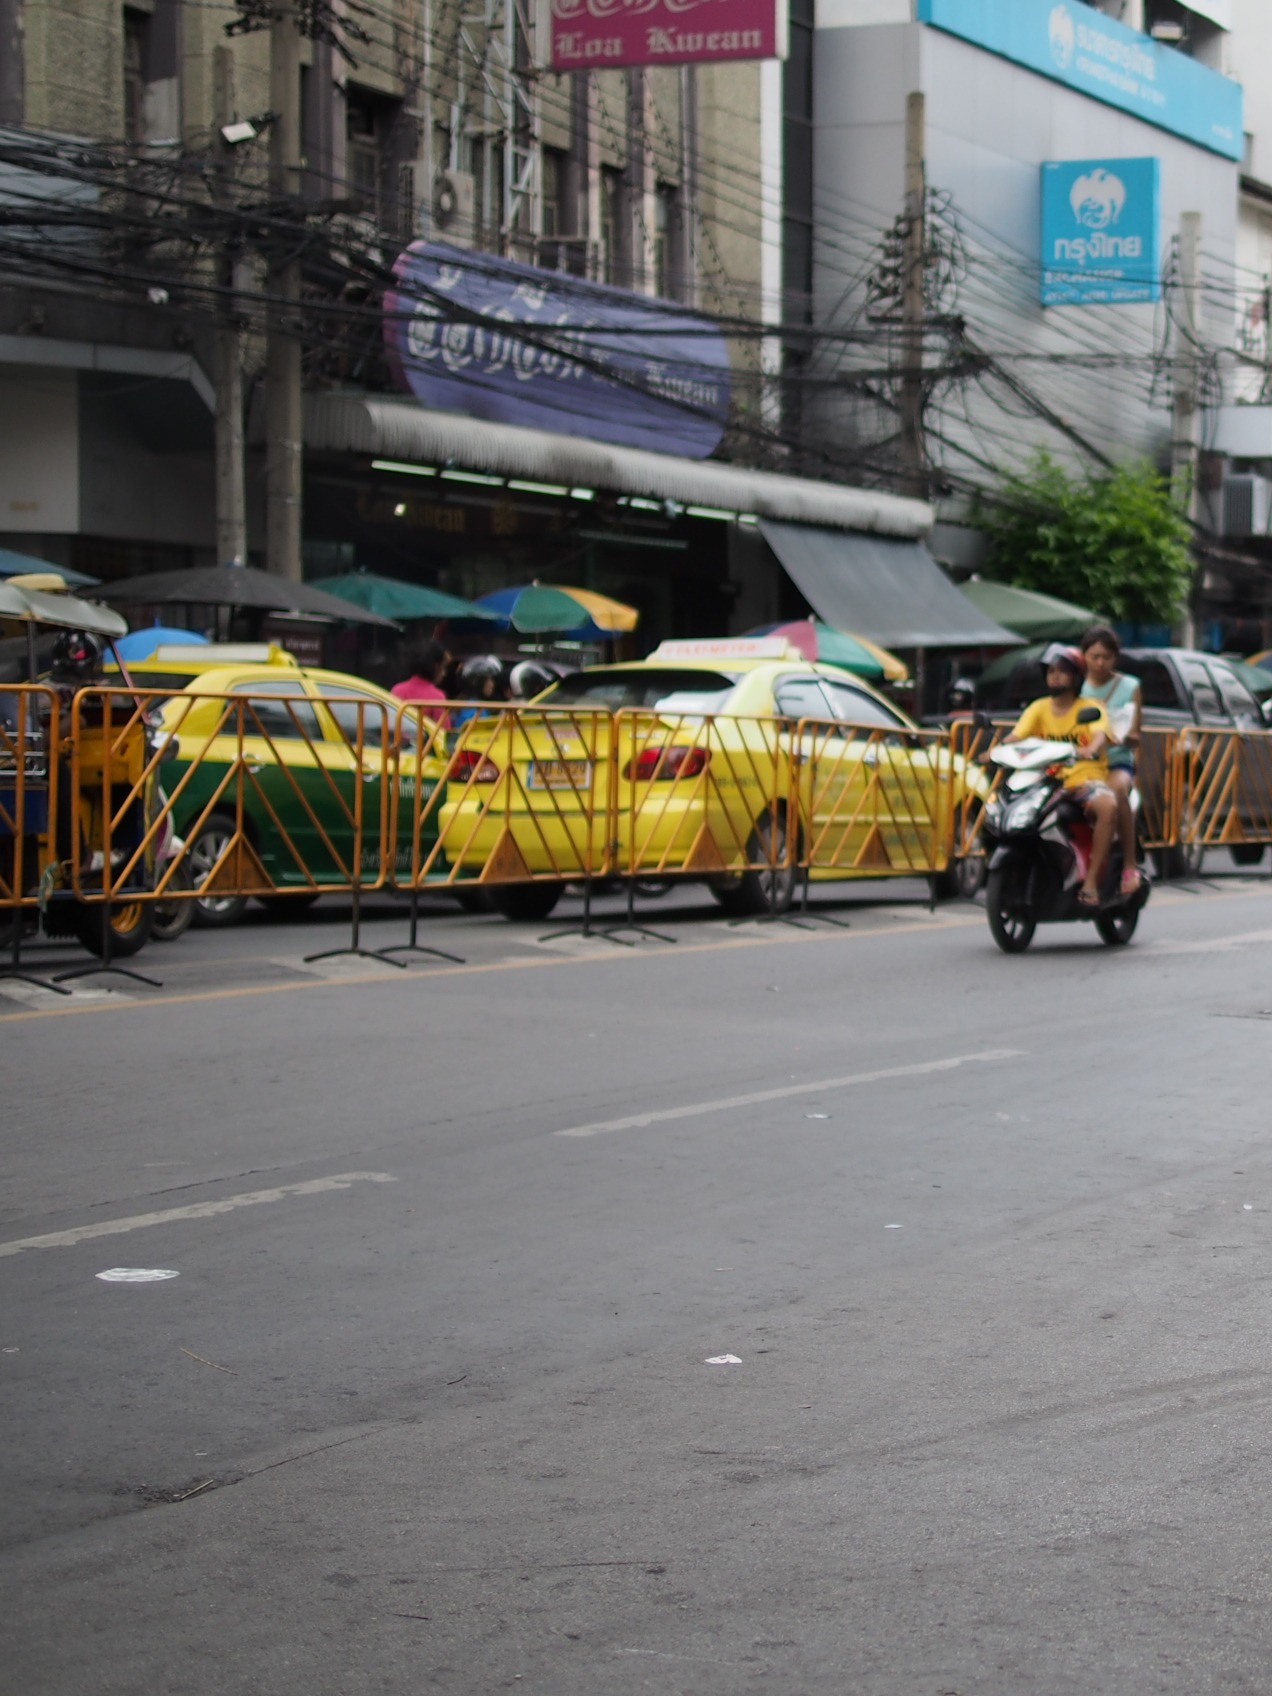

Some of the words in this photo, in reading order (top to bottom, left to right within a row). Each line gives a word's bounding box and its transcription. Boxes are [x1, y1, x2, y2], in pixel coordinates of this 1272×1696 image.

[646, 27, 762, 55] Kwean
[1054, 232, 1142, 266] กรุงไทย
